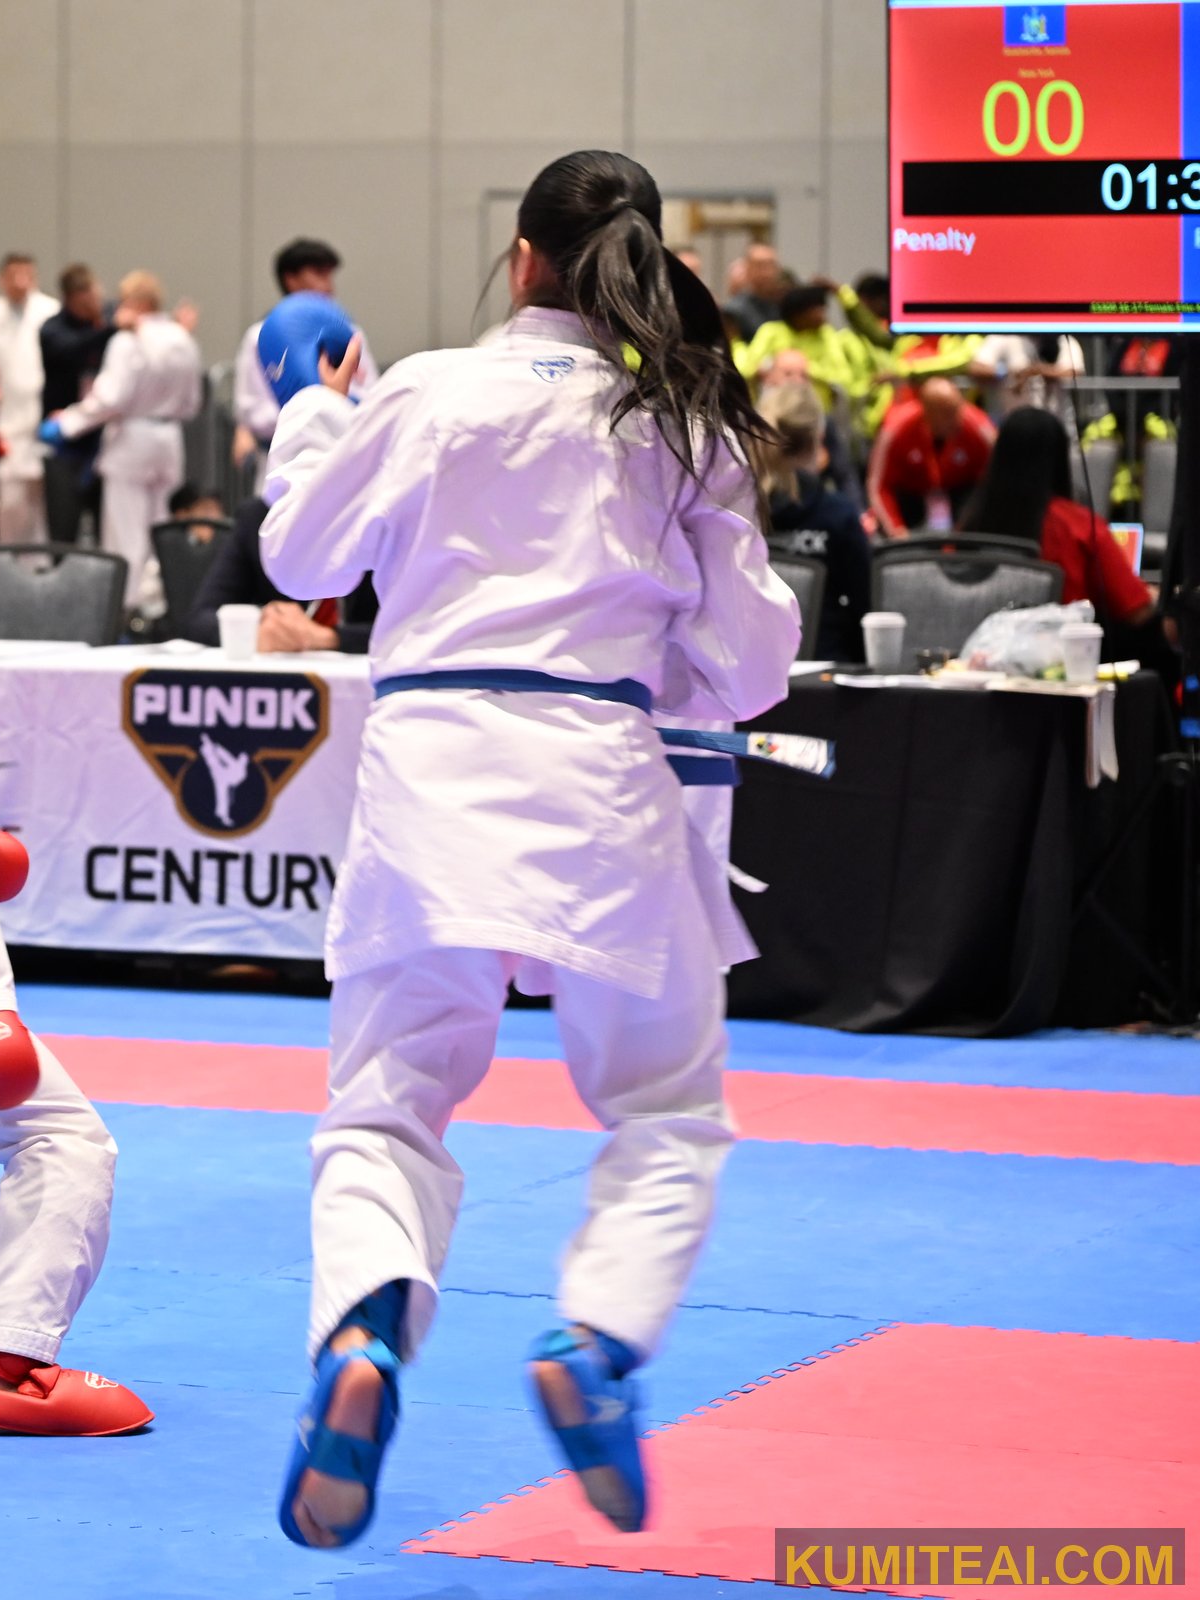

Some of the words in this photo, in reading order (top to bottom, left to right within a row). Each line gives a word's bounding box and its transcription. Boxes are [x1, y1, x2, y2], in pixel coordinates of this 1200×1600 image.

[982, 79, 1084, 156] 00
[893, 226, 976, 255] Penalty
[132, 683, 316, 731] PUNOK
